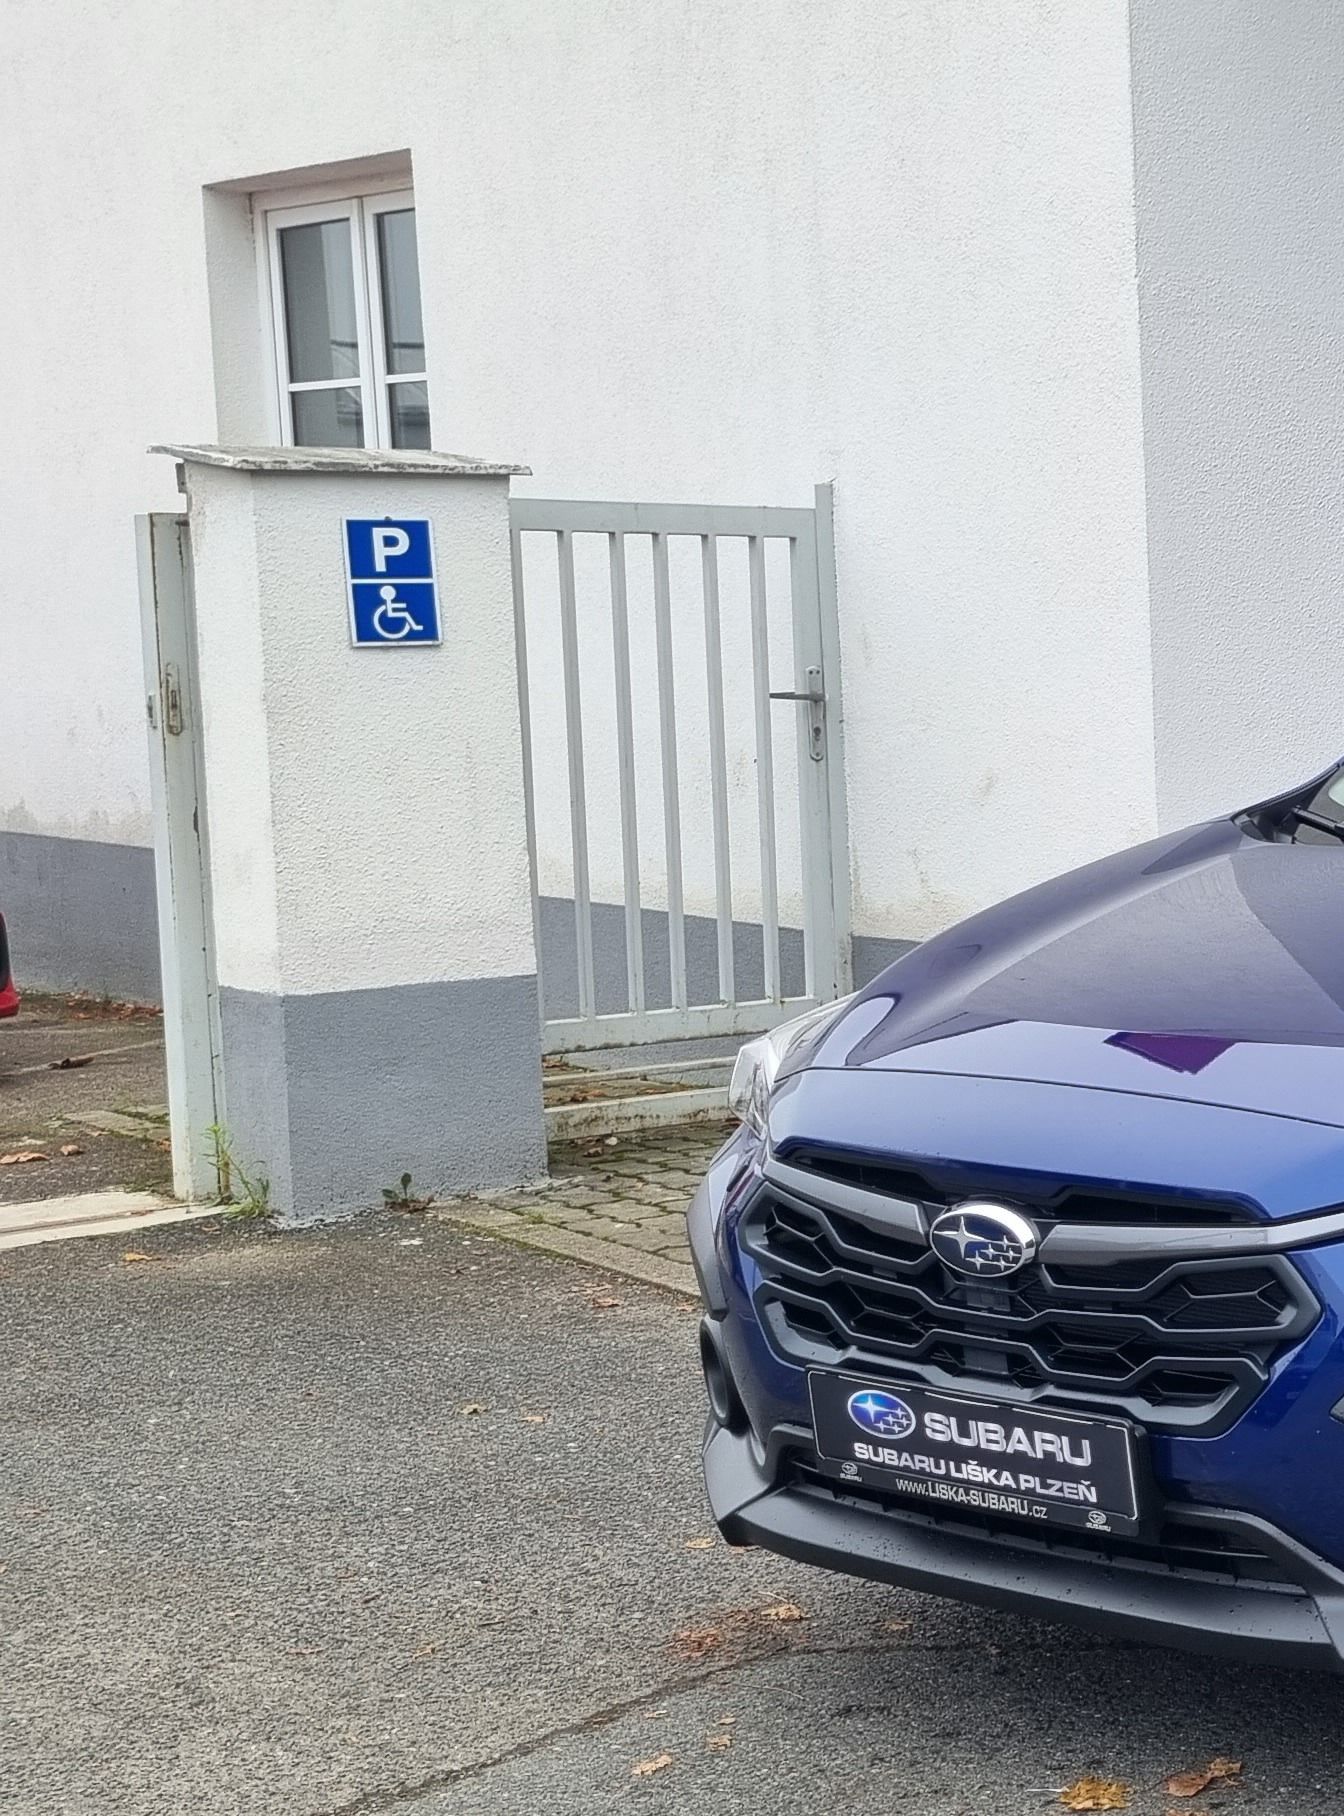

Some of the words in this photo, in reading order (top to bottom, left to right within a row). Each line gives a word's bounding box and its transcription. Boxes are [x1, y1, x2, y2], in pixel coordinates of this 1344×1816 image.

[372, 527, 410, 572] P
[923, 1411, 1092, 1467] SUBARU
[854, 1442, 947, 1475] SUBARU
[948, 1459, 1017, 1489] LIŠKA
[1019, 1473, 1097, 1503] PLZEŇ
[896, 1479, 1048, 1519] www.LISKA-SUBARU.cz
